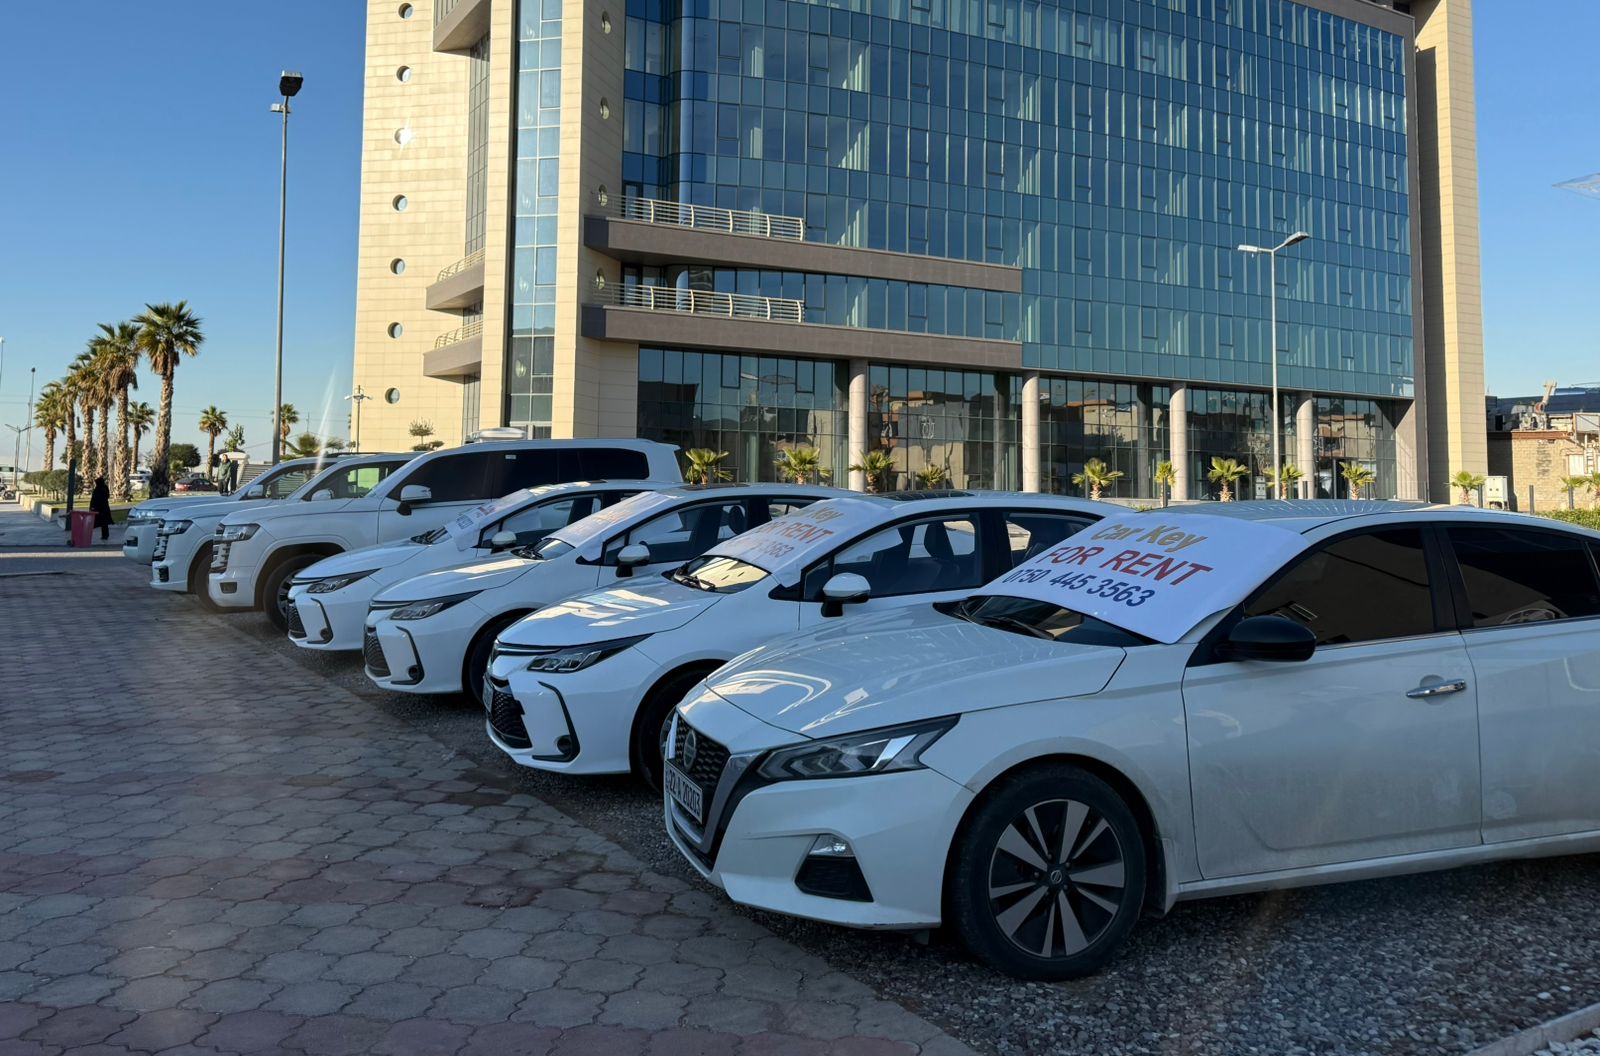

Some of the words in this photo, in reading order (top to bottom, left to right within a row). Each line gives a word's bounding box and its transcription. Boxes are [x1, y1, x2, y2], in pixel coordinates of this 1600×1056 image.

[781, 522, 833, 544] RENT
[1090, 524, 1144, 541] Car
[1141, 525, 1208, 553] Key
[1035, 546, 1105, 565] FOR
[1099, 549, 1213, 586] RENT
[1002, 568, 1052, 584] 0750
[1049, 571, 1096, 591] 445
[1086, 578, 1156, 608] 3563
